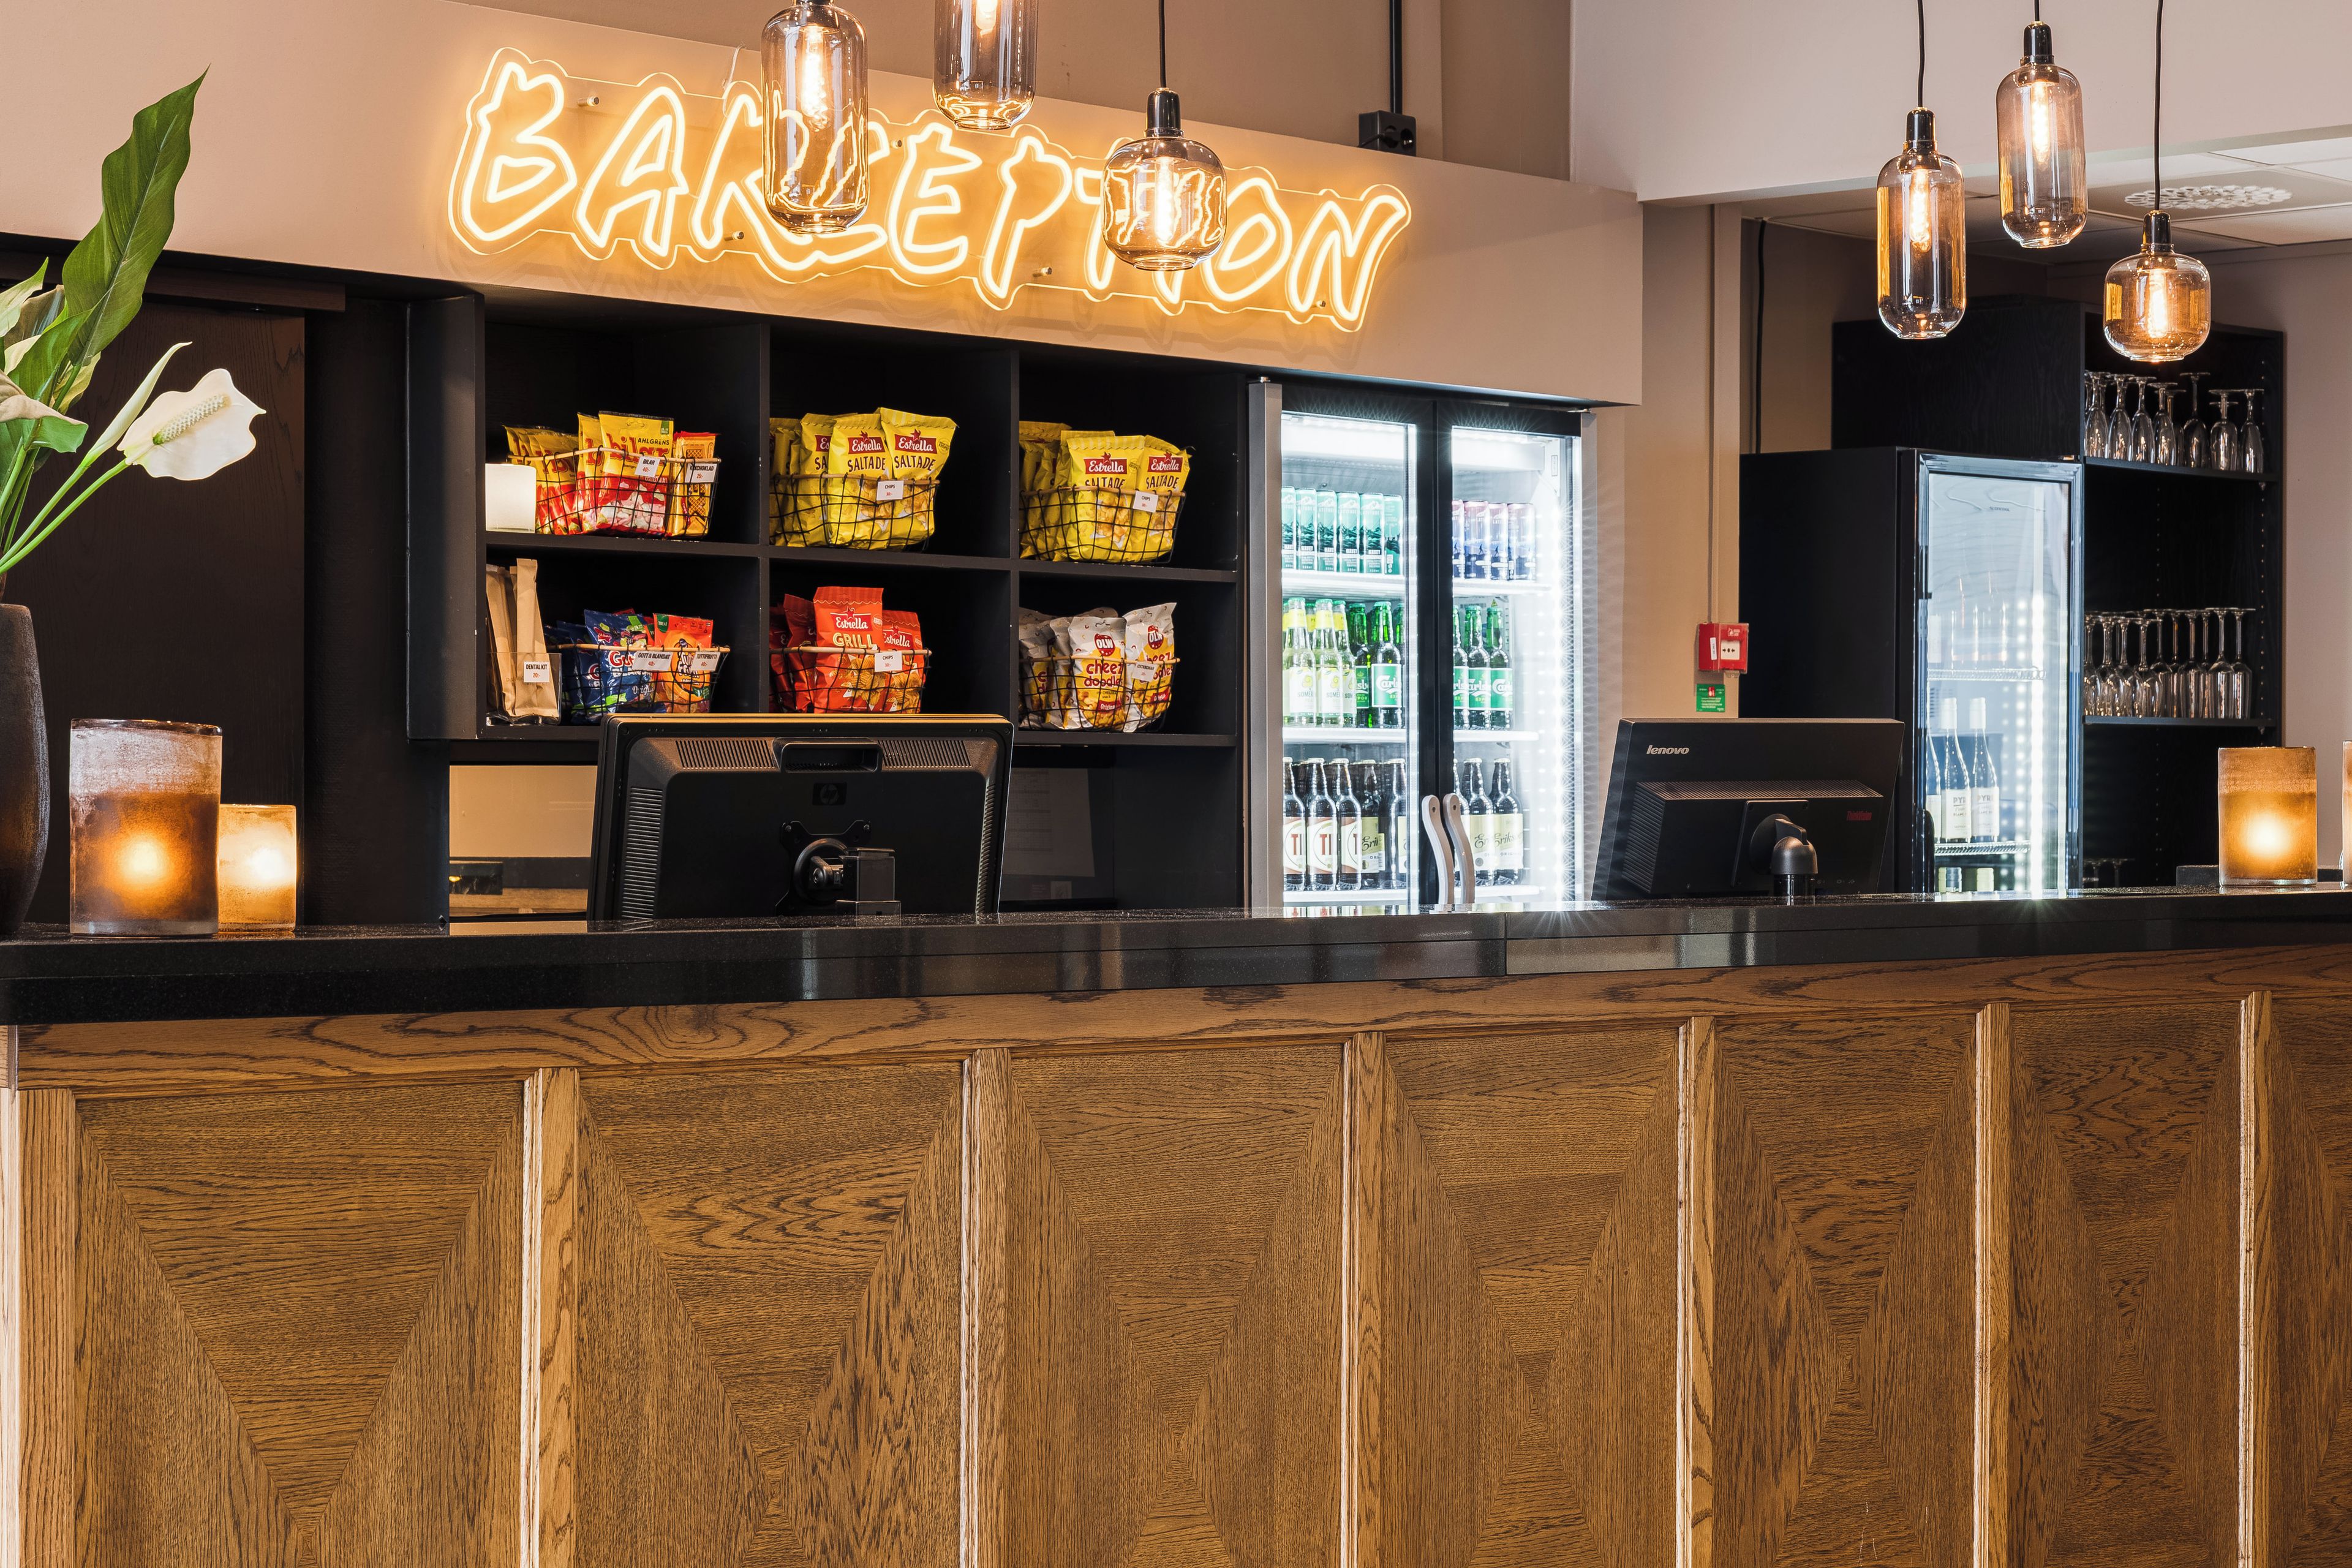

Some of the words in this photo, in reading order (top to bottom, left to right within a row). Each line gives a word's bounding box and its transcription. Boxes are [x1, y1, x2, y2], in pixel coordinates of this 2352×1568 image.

[461, 61, 1407, 322] BARCEPTON
[638, 437, 669, 446] AHLGRENS
[851, 439, 883, 452] Estrella
[897, 437, 933, 452] Estrella
[847, 456, 886, 472] SALTADE
[894, 455, 936, 471] SALTADE
[1088, 461, 1125, 473] Estrella
[1150, 458, 1180, 471] Estrella
[1085, 477, 1126, 488] SALTADE
[1146, 475, 1180, 489] SALTADE
[835, 617, 869, 630] Estrella
[833, 632, 878, 650] GRILL
[1096, 638, 1114, 649] OLW
[1149, 631, 1163, 643] OLW
[1086, 659, 1123, 674] cheez
[1084, 675, 1123, 687] doodles
[1646, 745, 1689, 755] lenovo
[1846, 810, 1872, 821] ThinkVision
